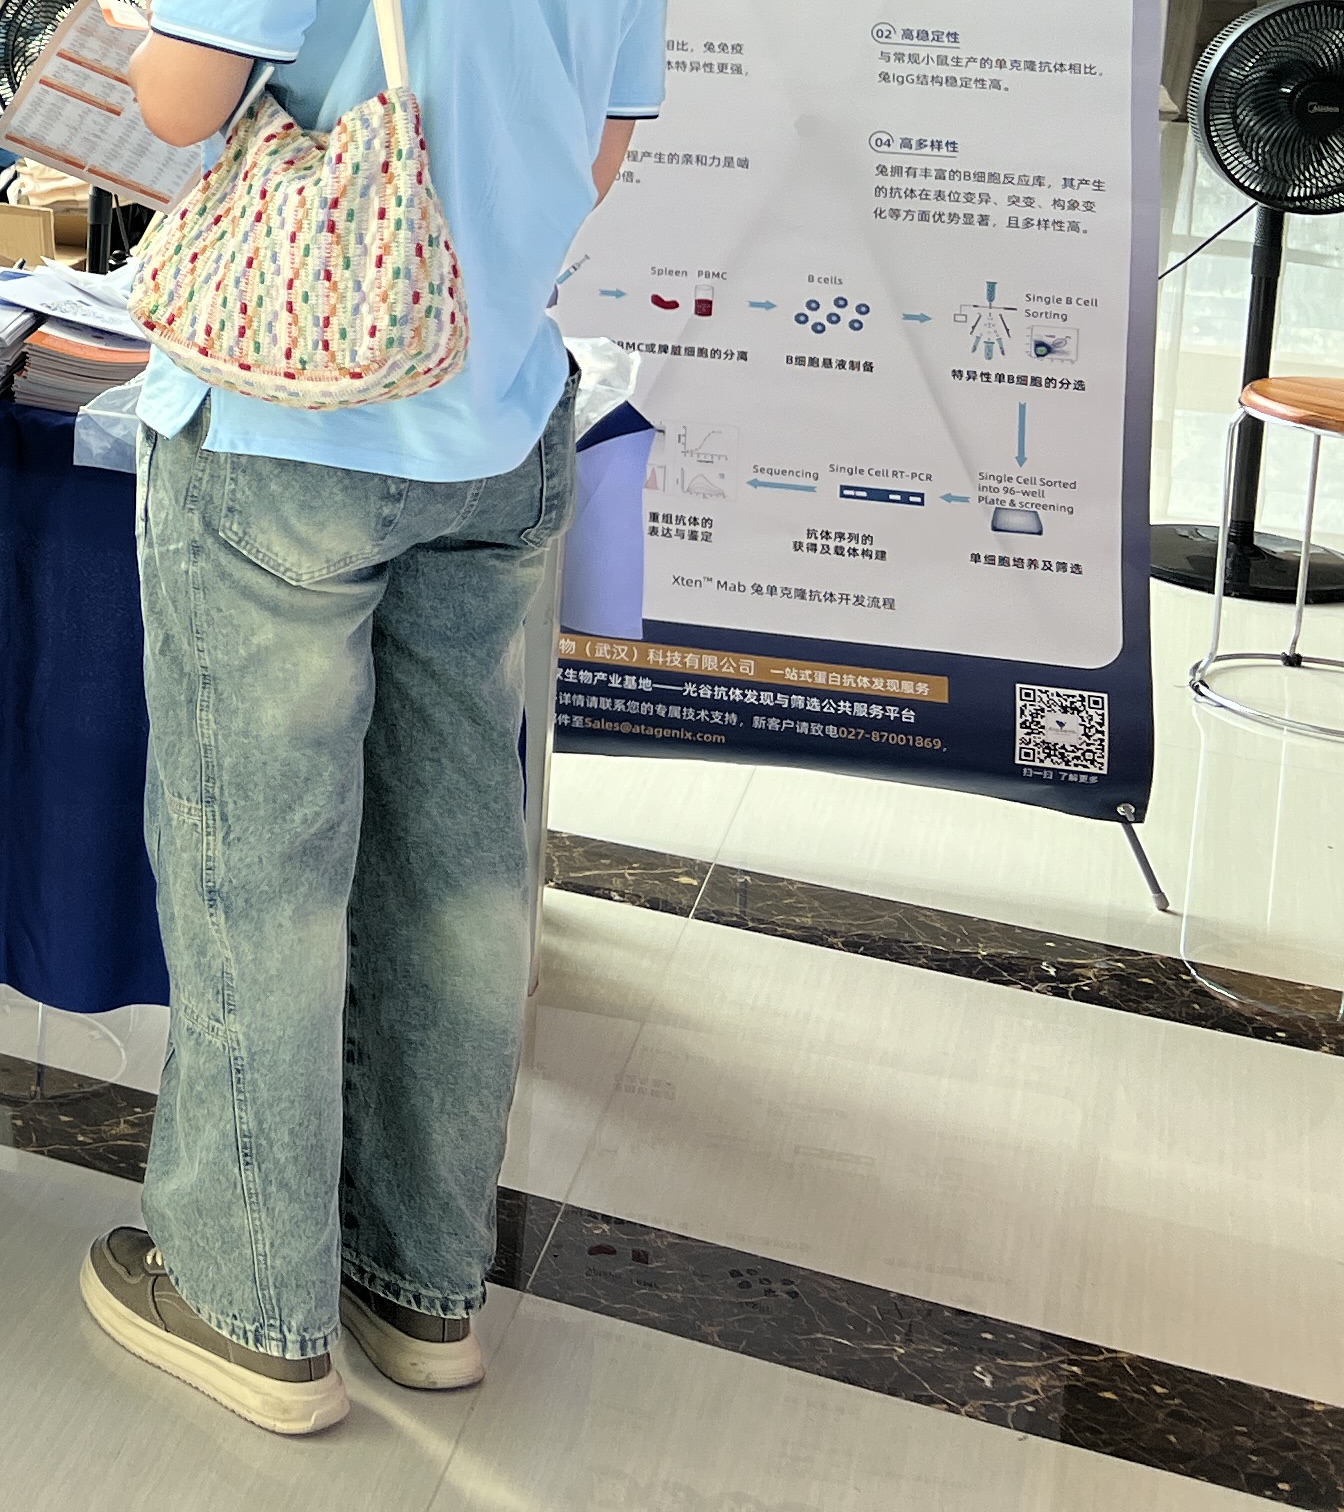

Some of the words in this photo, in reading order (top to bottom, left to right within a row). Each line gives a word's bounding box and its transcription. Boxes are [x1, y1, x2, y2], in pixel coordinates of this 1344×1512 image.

[875, 28, 893, 39] 02
[874, 138, 892, 149] 04
[650, 266, 689, 278] Spleen
[697, 269, 729, 281] PBMC
[816, 274, 844, 286] cells
[1024, 292, 1063, 306] Single
[1065, 295, 1074, 306] B
[1075, 296, 1100, 308] Cell
[1023, 308, 1069, 323] Sorting
[752, 464, 820, 481] Sequencing
[828, 463, 866, 477] Single
[867, 467, 890, 479] Cell
[891, 469, 933, 483] RT-PCR
[977, 471, 1014, 486] Single
[1015, 474, 1038, 486] Cell
[1039, 476, 1078, 491] Sorted
[977, 482, 1001, 495] into
[1002, 485, 1046, 500] 96-well
[977, 494, 1007, 508] Plate
[1018, 499, 1075, 516] screening
[716, 579, 748, 594] Mab
